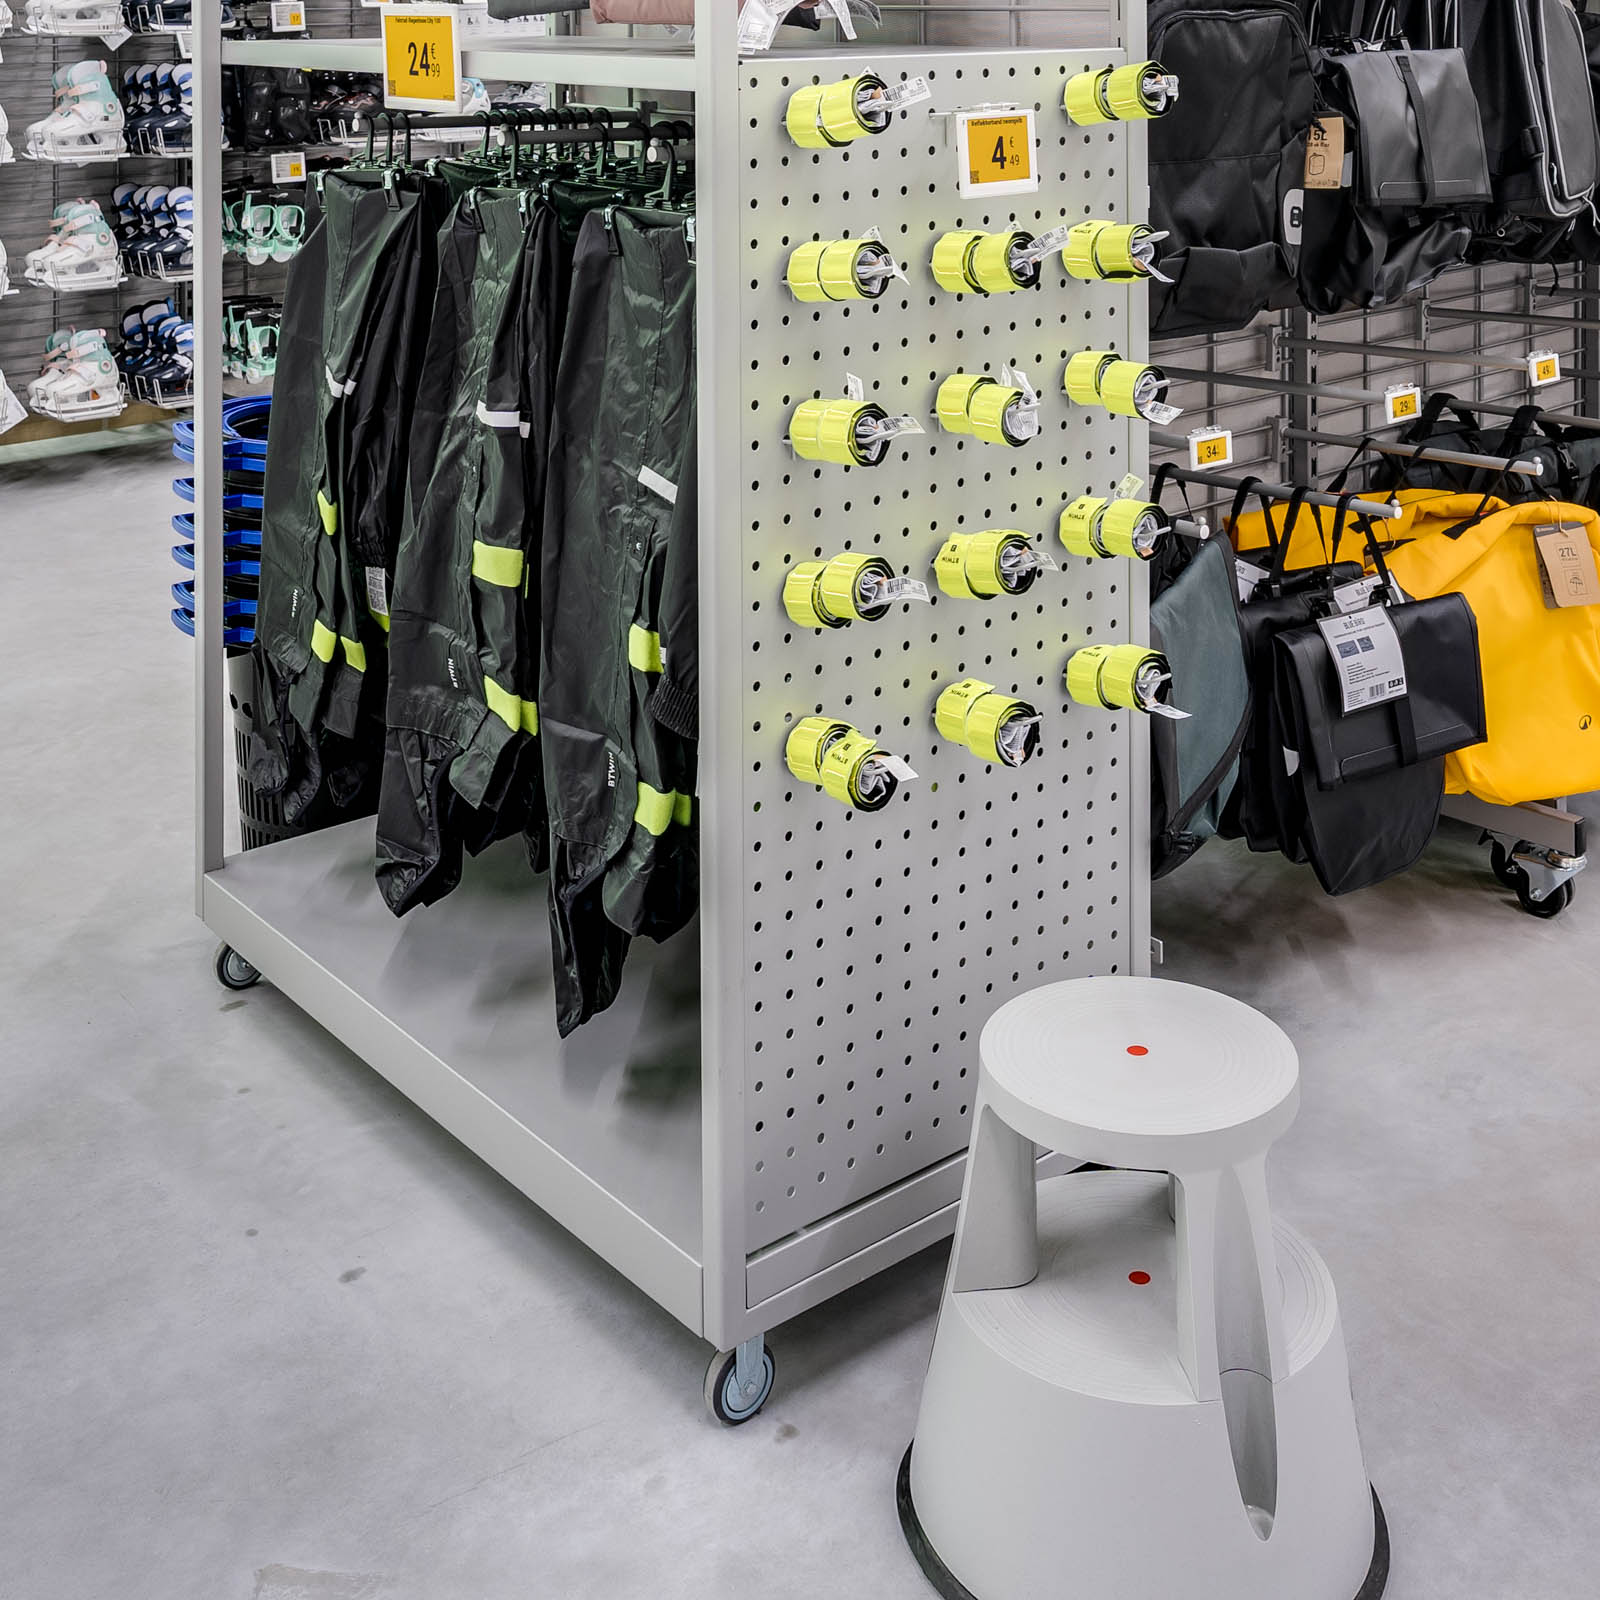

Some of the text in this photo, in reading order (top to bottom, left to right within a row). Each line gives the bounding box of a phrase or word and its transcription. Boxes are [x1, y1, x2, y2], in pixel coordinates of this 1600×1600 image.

[408, 42, 431, 77] 24
[992, 135, 1007, 169] 4
[1206, 444, 1217, 458] 34
[1558, 547, 1577, 558] 27L
[607, 751, 616, 788] BTWIN
